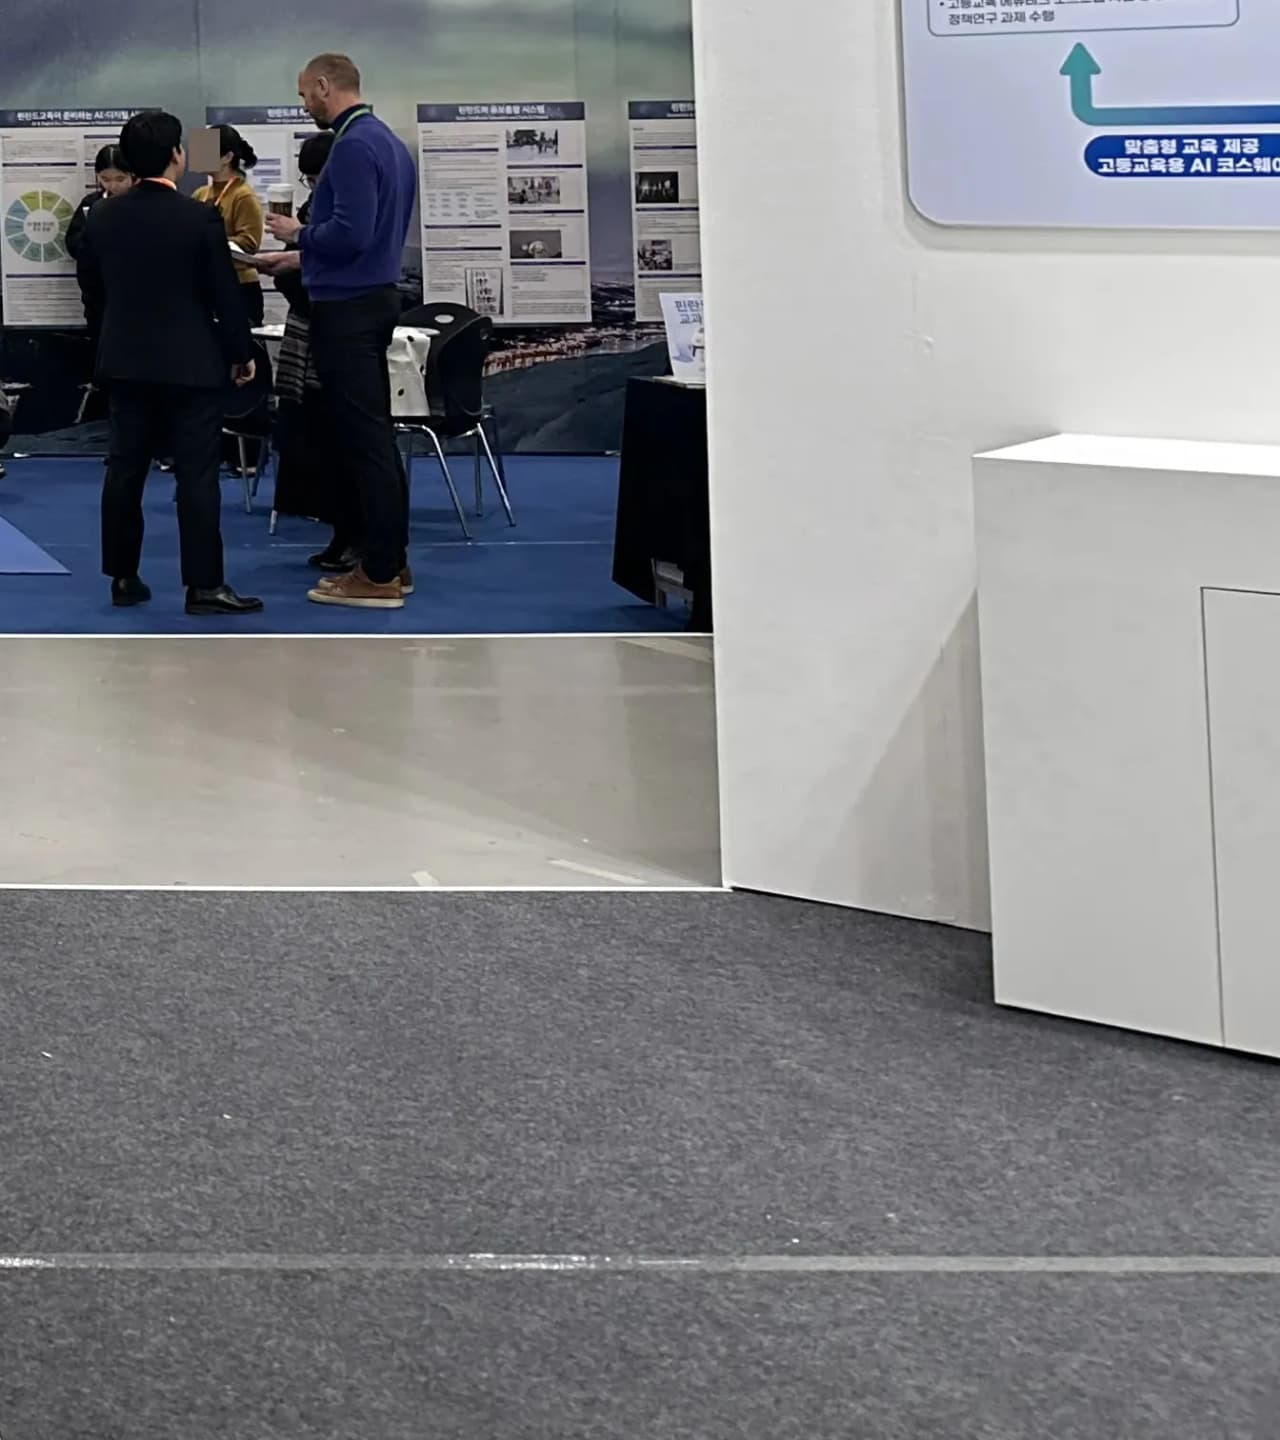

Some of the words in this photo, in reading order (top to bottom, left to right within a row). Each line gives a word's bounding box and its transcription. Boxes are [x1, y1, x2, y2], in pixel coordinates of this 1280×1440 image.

[1001, 10, 1026, 24] 과제
[1124, 139, 1177, 155] 맞춤형
[1182, 138, 1218, 154] 교육
[1223, 138, 1259, 154] 제공
[1097, 158, 1184, 173] 고등교육용
[1190, 157, 1211, 173] AI
